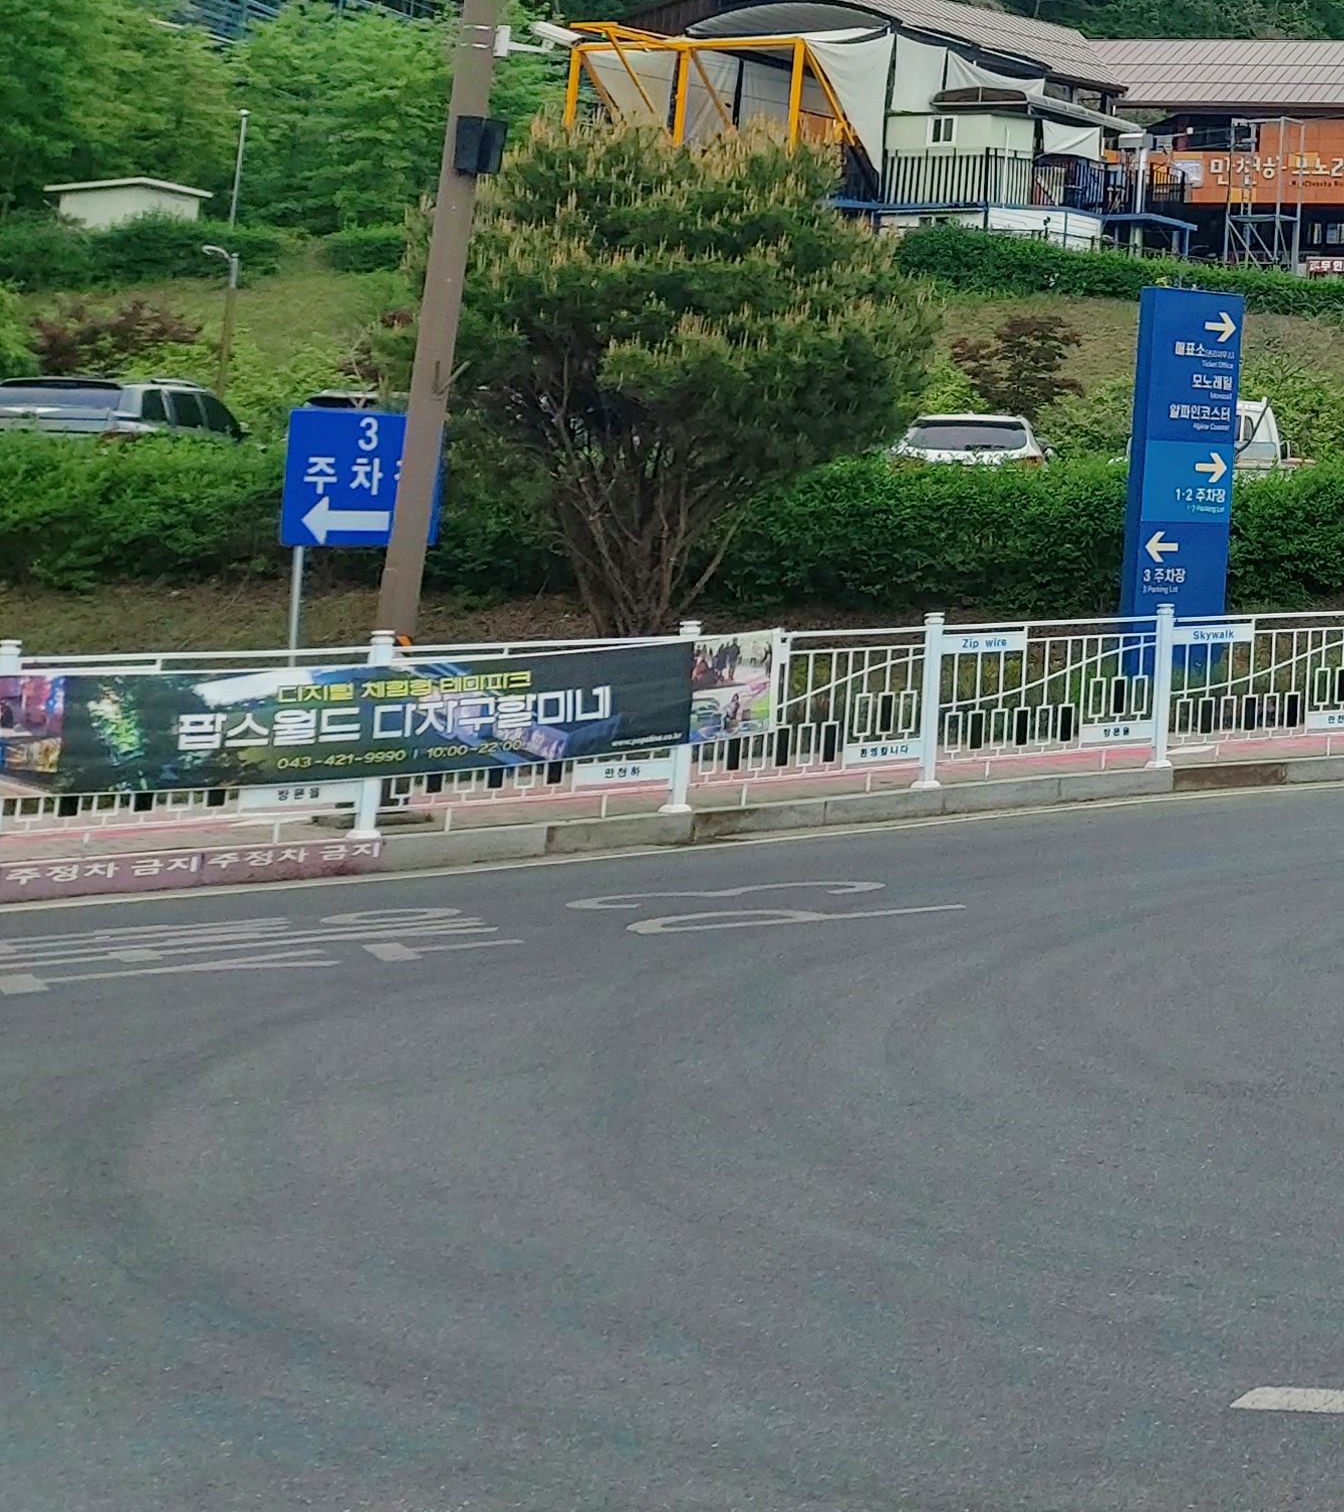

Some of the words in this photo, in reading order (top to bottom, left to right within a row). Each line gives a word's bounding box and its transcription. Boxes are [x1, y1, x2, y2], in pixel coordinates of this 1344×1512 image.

[1192, 374, 1232, 390] 모노레일
[1169, 403, 1231, 422] 알파인코스터
[357, 417, 379, 452] 3
[303, 457, 403, 496] 주차
[1196, 488, 1227, 503] 주차장
[1143, 569, 1151, 582] 3
[1154, 569, 1186, 583] 주차장
[962, 638, 979, 649] Zip
[985, 638, 1007, 647] wire
[1193, 629, 1234, 640] Skywalk
[278, 682, 354, 703] 디지털
[361, 678, 433, 700] 체험형
[177, 706, 361, 751] 팝스월드
[373, 685, 612, 740] 다자구할미네
[277, 749, 407, 770] 043-421-9990
[208, 843, 309, 870] 주정차
[319, 841, 383, 862] 금지
[5, 862, 120, 886] 주정차
[131, 856, 200, 876] 금지
